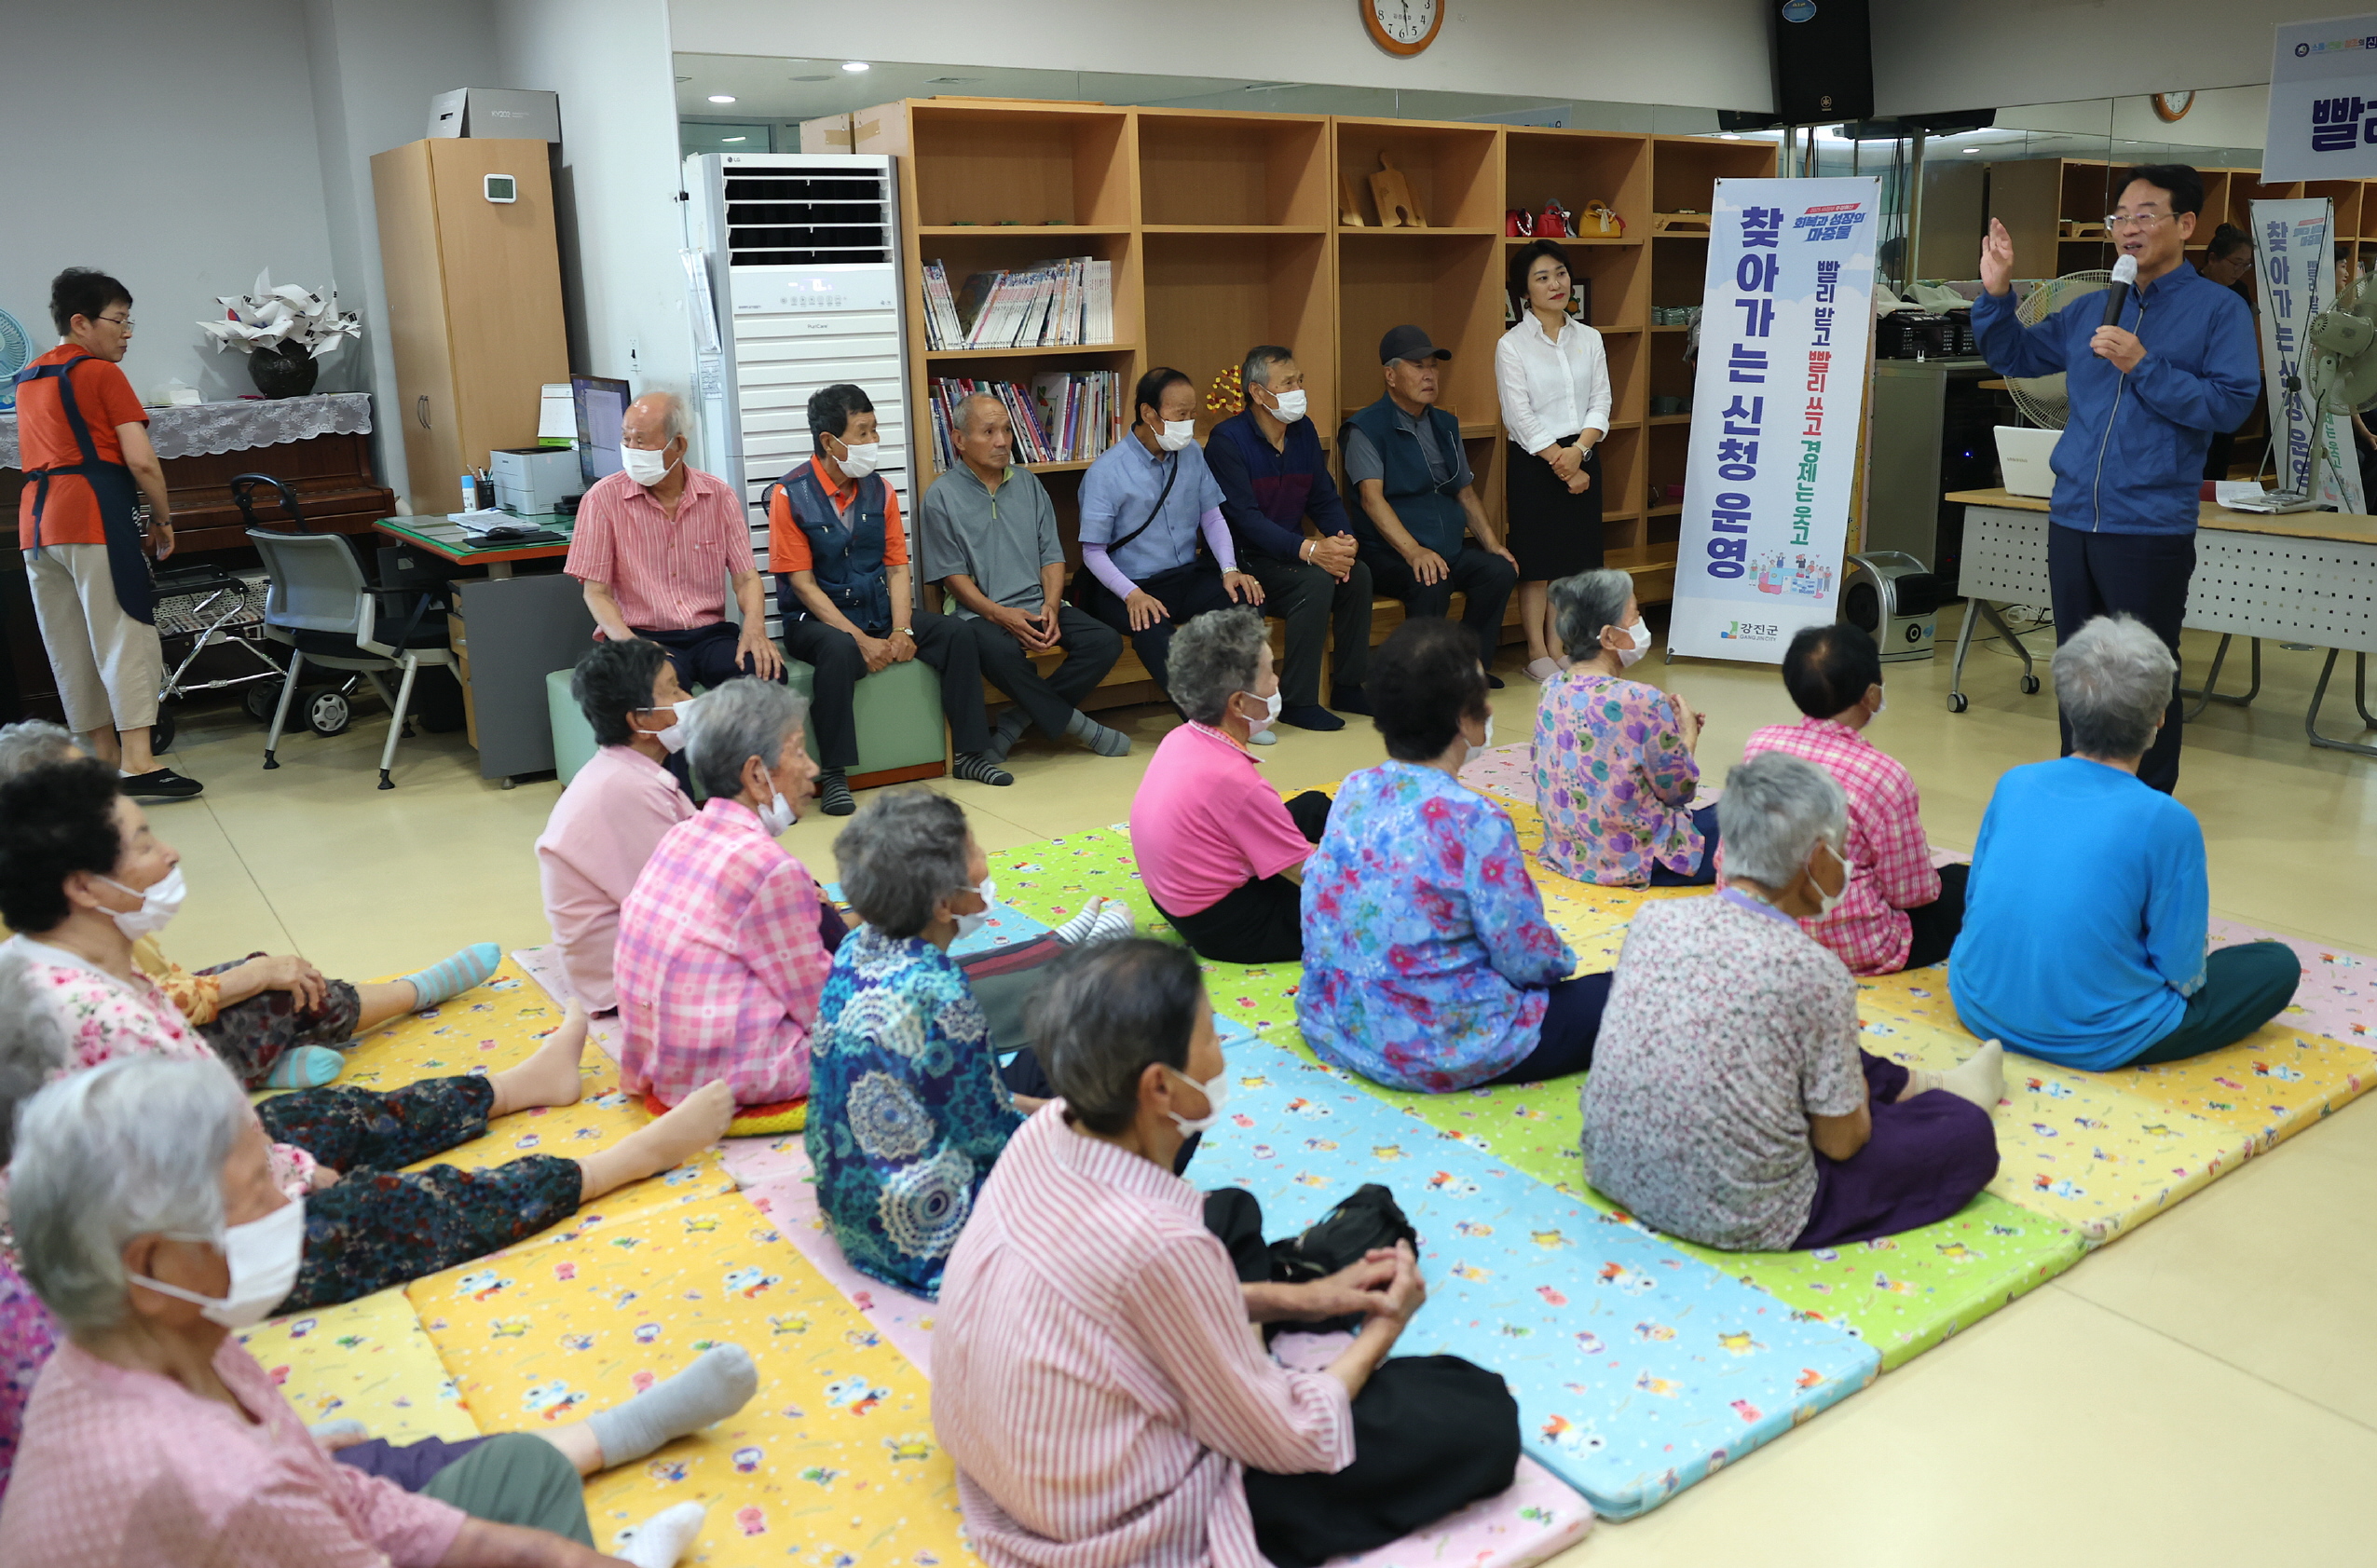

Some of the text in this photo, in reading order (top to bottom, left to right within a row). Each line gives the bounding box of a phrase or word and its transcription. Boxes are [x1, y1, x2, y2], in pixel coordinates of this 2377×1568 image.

[1377, 9, 1385, 20] 8
[1420, 15, 1427, 25] 4
[1387, 23, 1393, 34] 7
[1399, 28, 1405, 38] 6
[1411, 26, 1417, 36] 5
[1793, 212, 1866, 228] 회복과 성장의
[1804, 225, 1853, 242] 마중물
[2266, 220, 2294, 352] 찾아가는
[1706, 207, 1784, 579] 찾아가는 신청 운영
[1790, 260, 1840, 546] 빨리 받고 빨리 쓰고 경제는 웃고
[1740, 623, 1778, 636] 강진군
